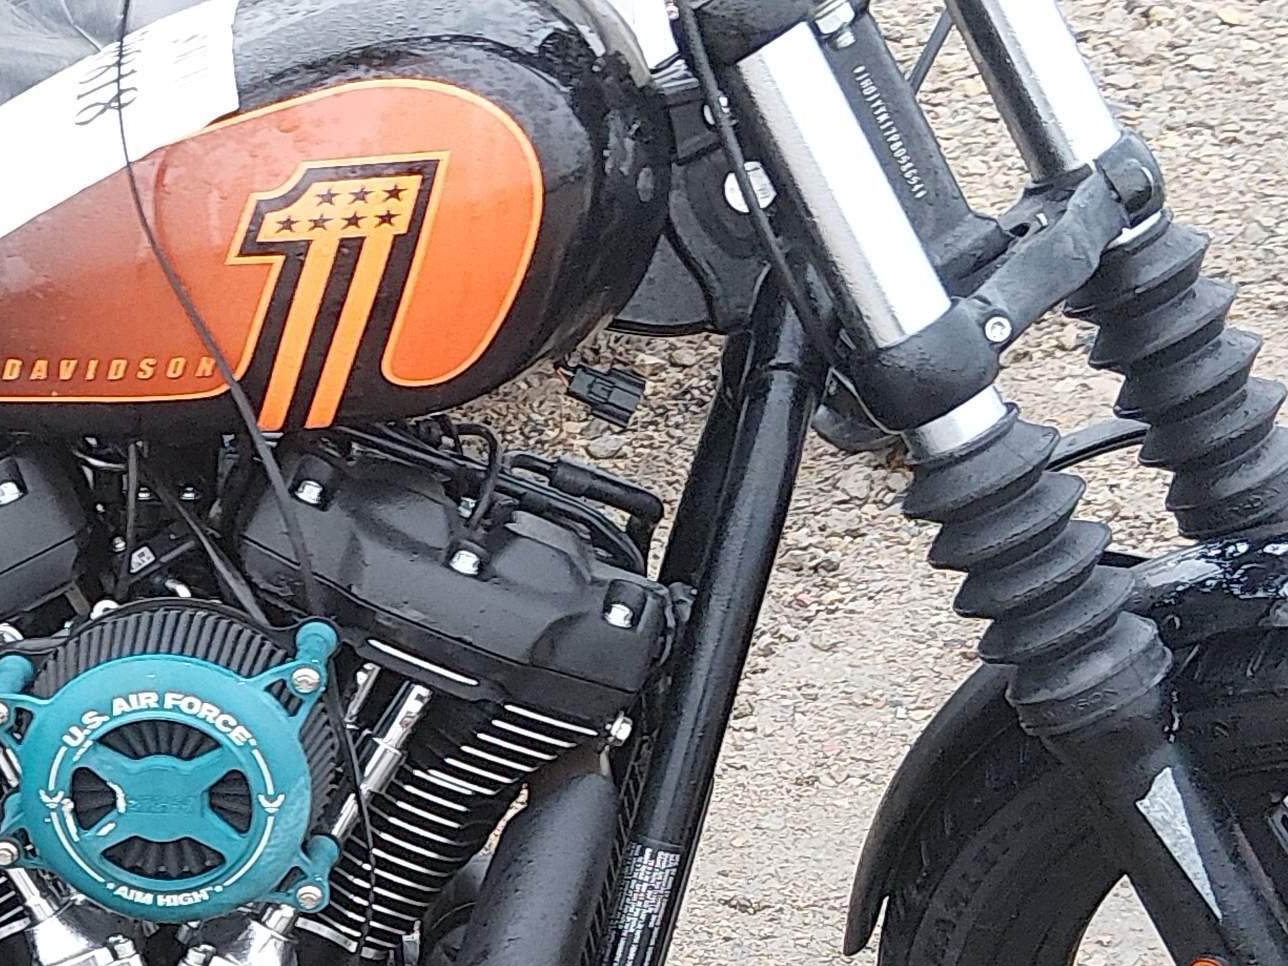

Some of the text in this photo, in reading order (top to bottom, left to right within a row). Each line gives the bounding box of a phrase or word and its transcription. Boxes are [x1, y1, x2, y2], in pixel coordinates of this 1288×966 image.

[63, 691, 254, 748] U.S. AIR FORCE
[112, 884, 209, 907] AIM HIGH
